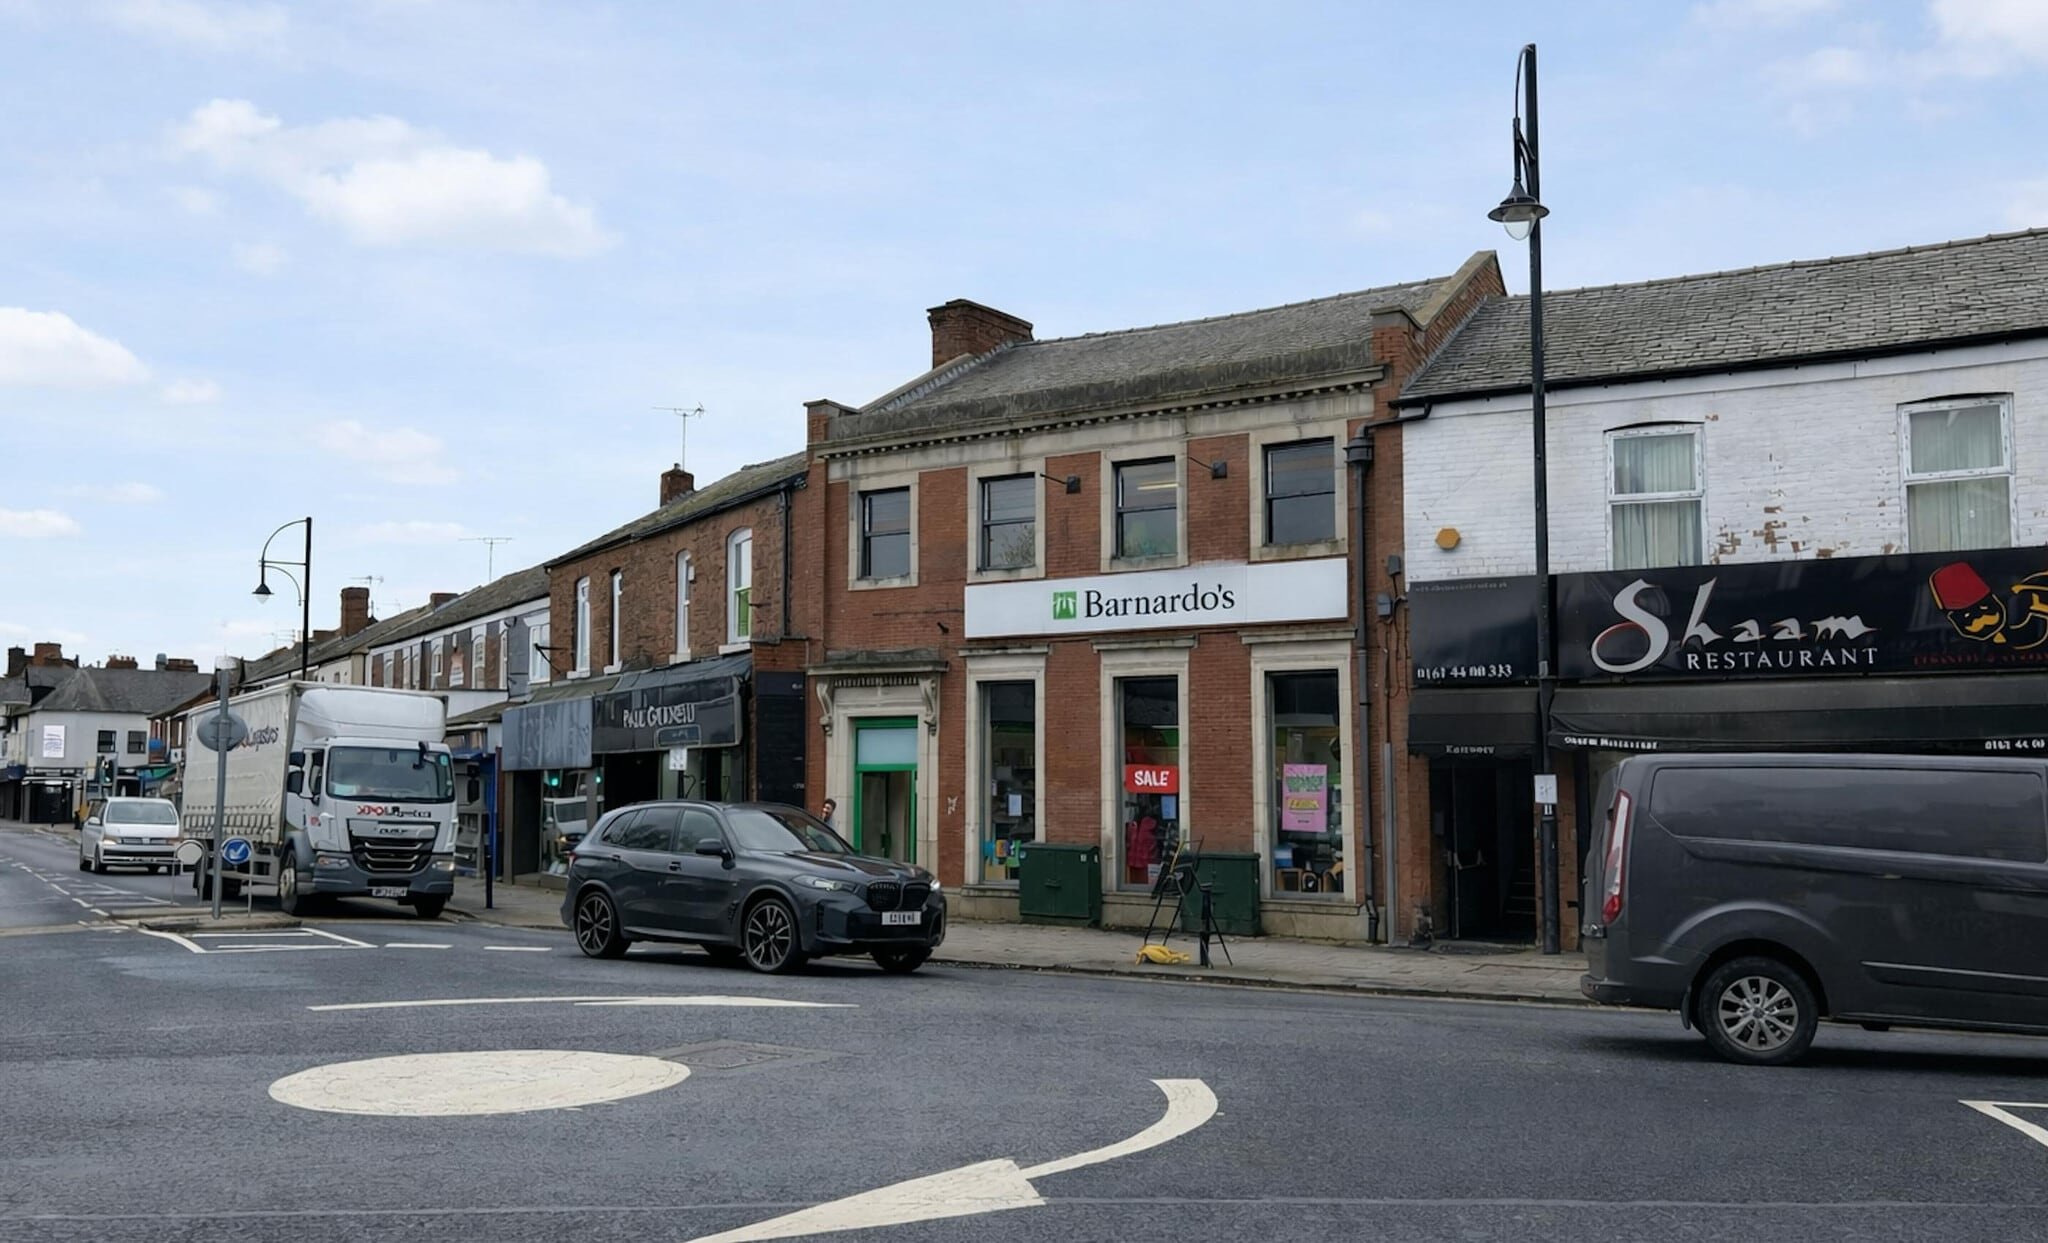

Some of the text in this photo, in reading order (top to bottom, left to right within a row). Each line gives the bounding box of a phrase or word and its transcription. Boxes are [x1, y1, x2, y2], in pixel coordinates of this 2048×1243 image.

[1084, 583, 1235, 618] Barnardo's
[1591, 577, 1881, 673] Shaam
[1687, 648, 1878, 670] RESTAURANT
[1134, 769, 1170, 787] SALE
